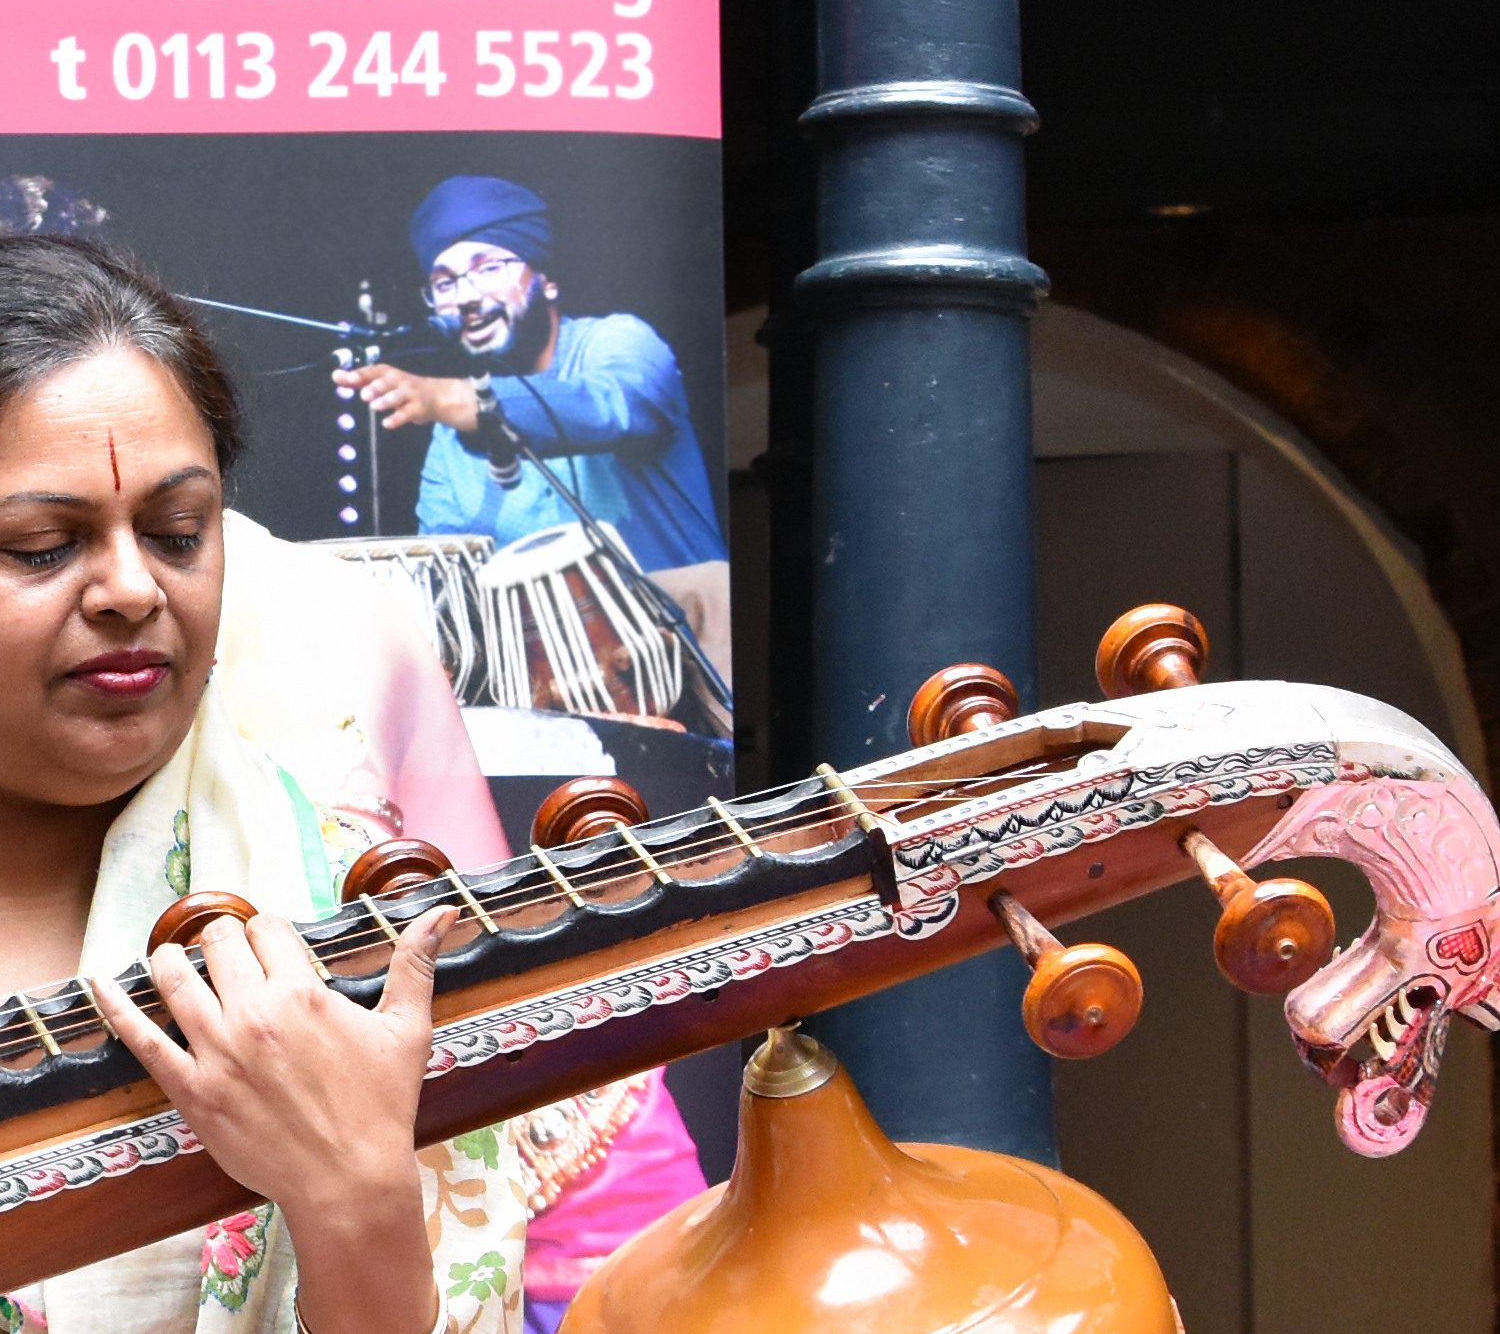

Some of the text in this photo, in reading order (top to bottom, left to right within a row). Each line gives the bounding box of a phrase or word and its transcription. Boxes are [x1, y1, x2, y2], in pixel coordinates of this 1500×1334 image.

[49, 29, 655, 102] t 0113 244 5523
